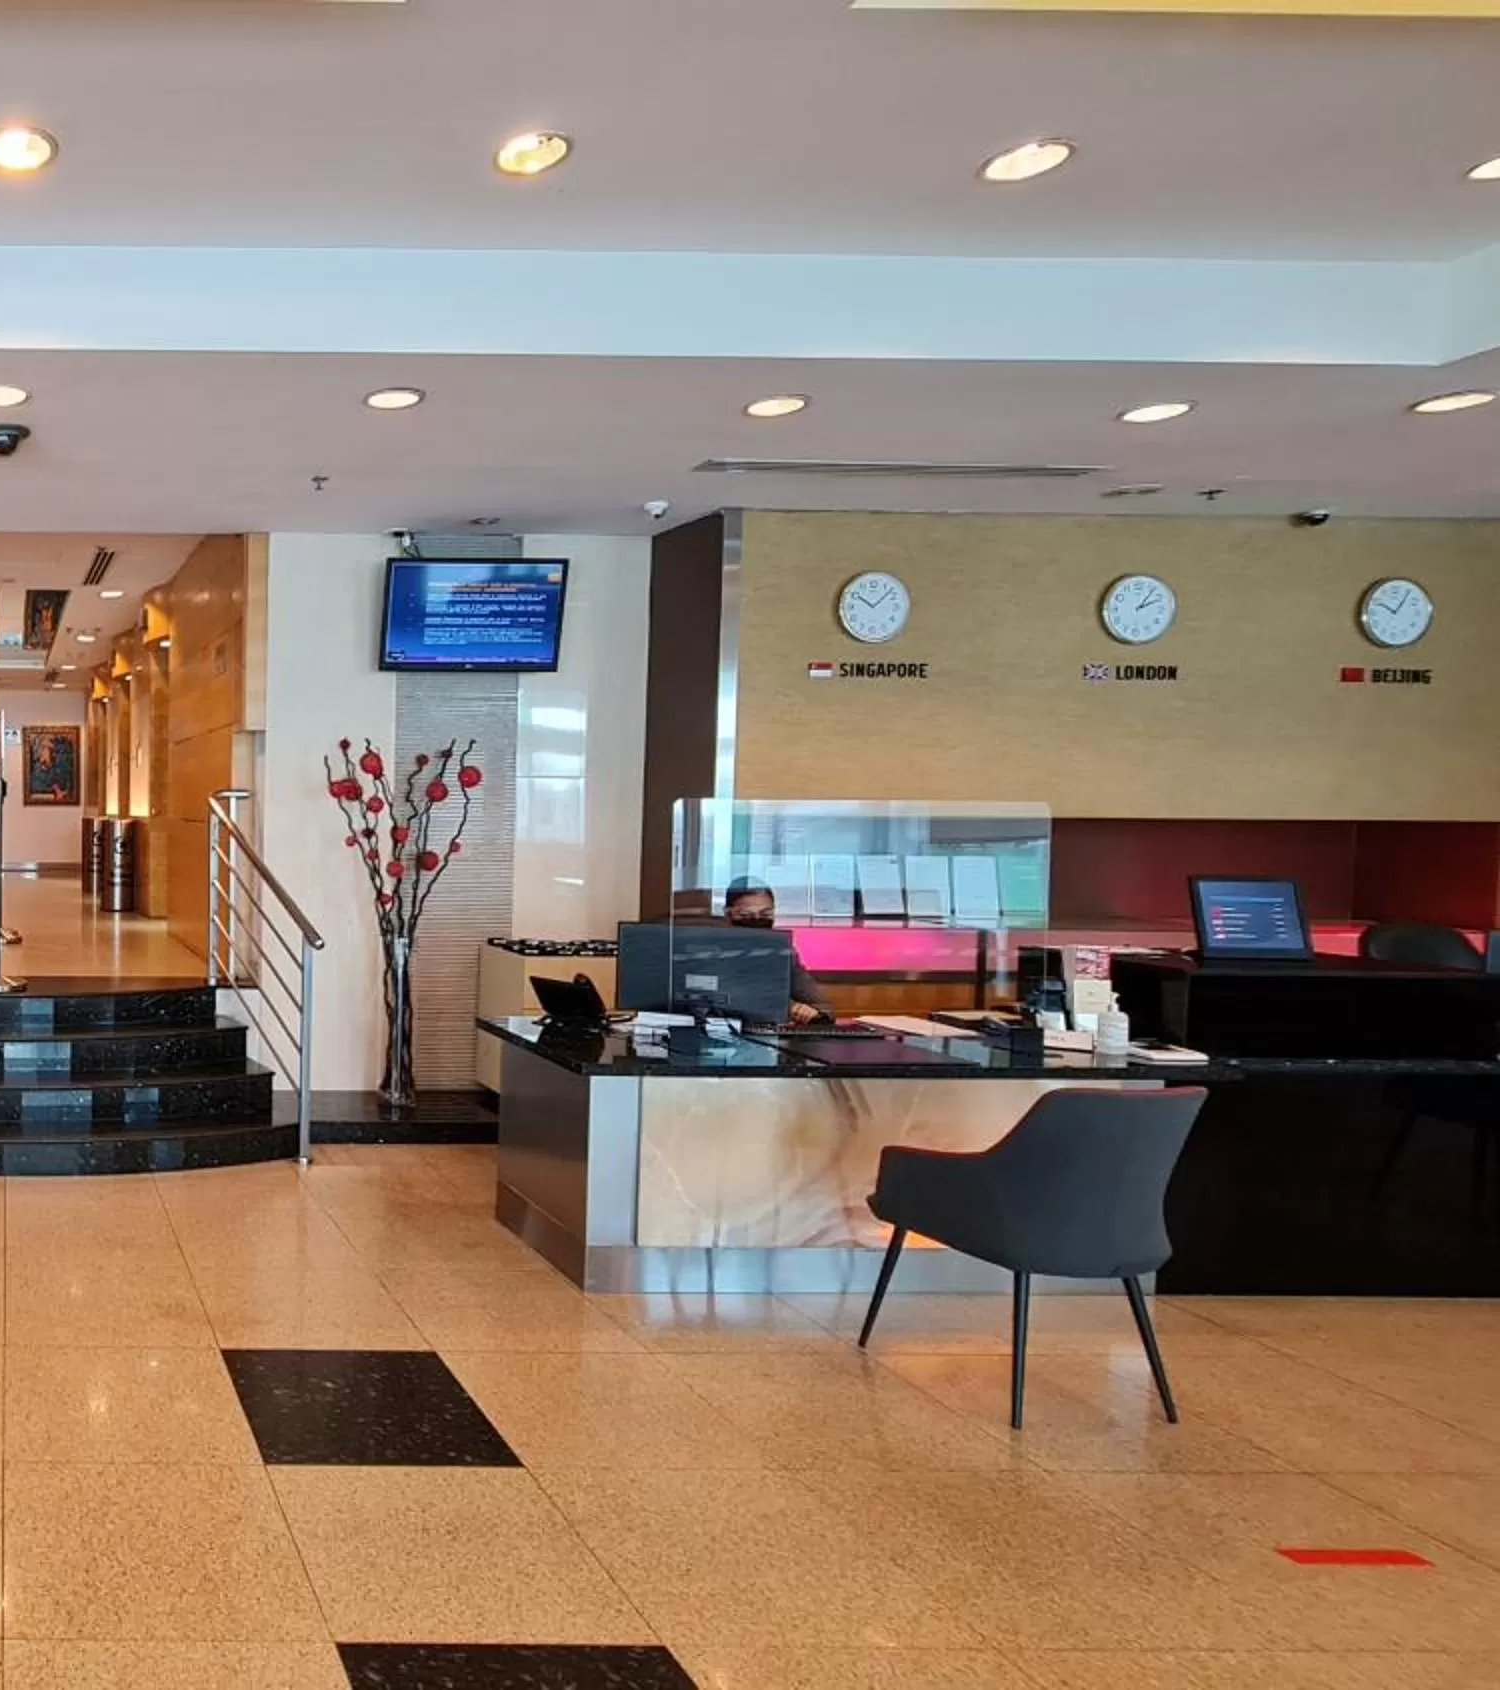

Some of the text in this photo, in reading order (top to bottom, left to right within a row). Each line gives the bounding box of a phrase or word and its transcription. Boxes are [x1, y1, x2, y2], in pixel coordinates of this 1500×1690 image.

[839, 662, 929, 679] SINGAPORE
[1115, 665, 1178, 681] LONDON
[1371, 668, 1432, 685] BEIJING
